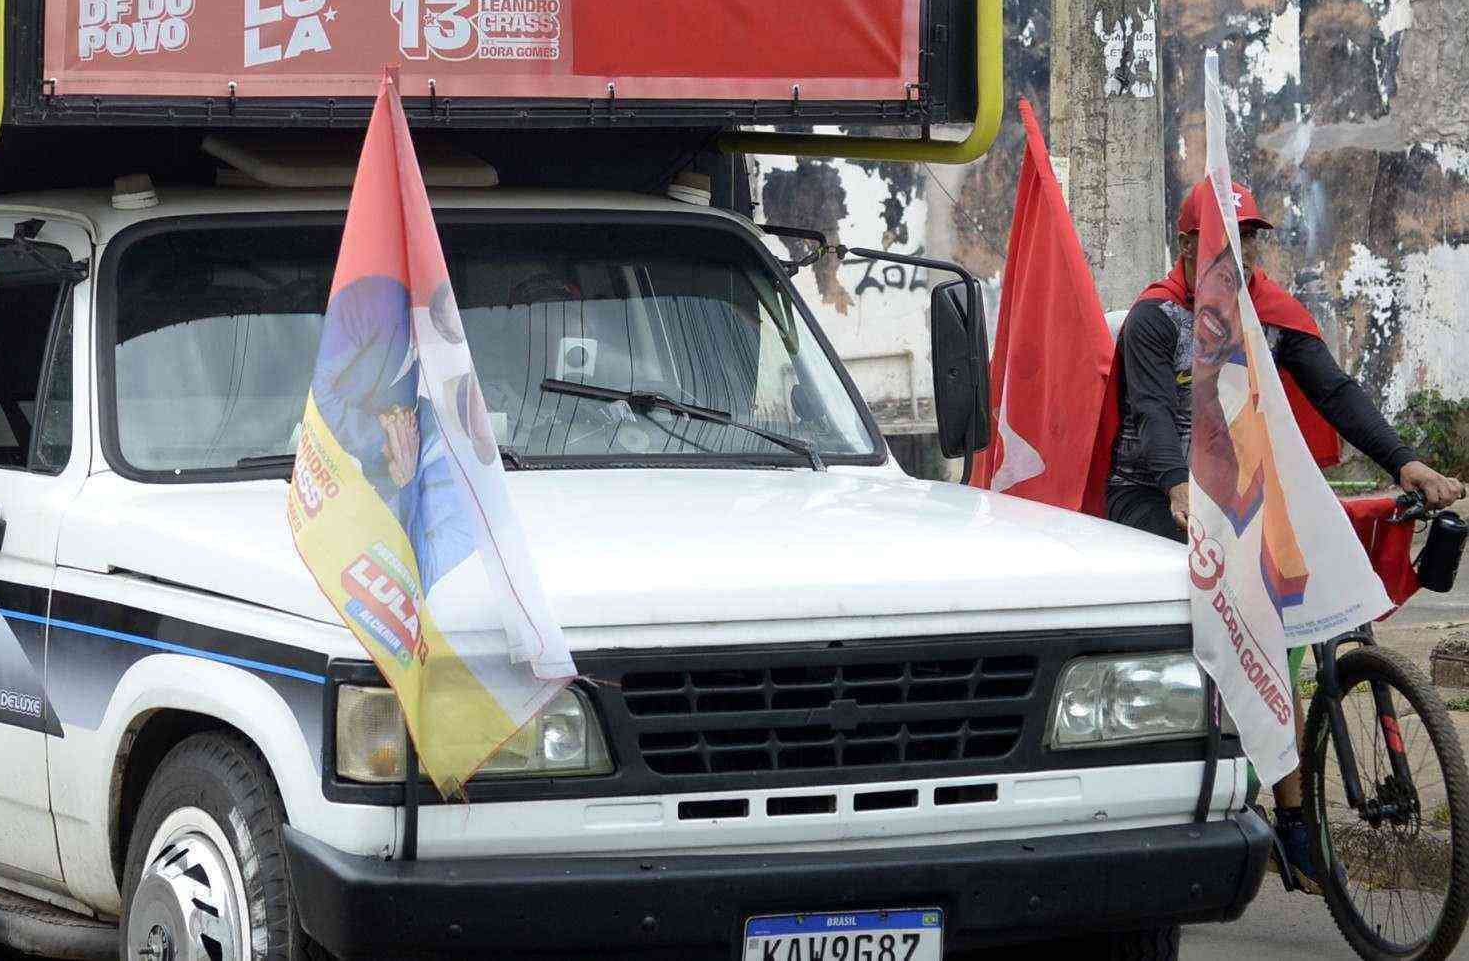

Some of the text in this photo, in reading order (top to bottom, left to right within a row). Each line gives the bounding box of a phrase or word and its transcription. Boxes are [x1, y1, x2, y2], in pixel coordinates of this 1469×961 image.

[481, 0, 559, 13] LEANDRO
[482, 13, 556, 35] GRASS
[78, 16, 190, 62] POVO
[481, 46, 558, 58] DORA GOMES
[348, 558, 419, 641] LULA
[1212, 590, 1244, 654] DORA
[1240, 648, 1292, 726] GOMES
[0, 690, 42, 717] DELUXE
[826, 916, 858, 927] BRASIL
